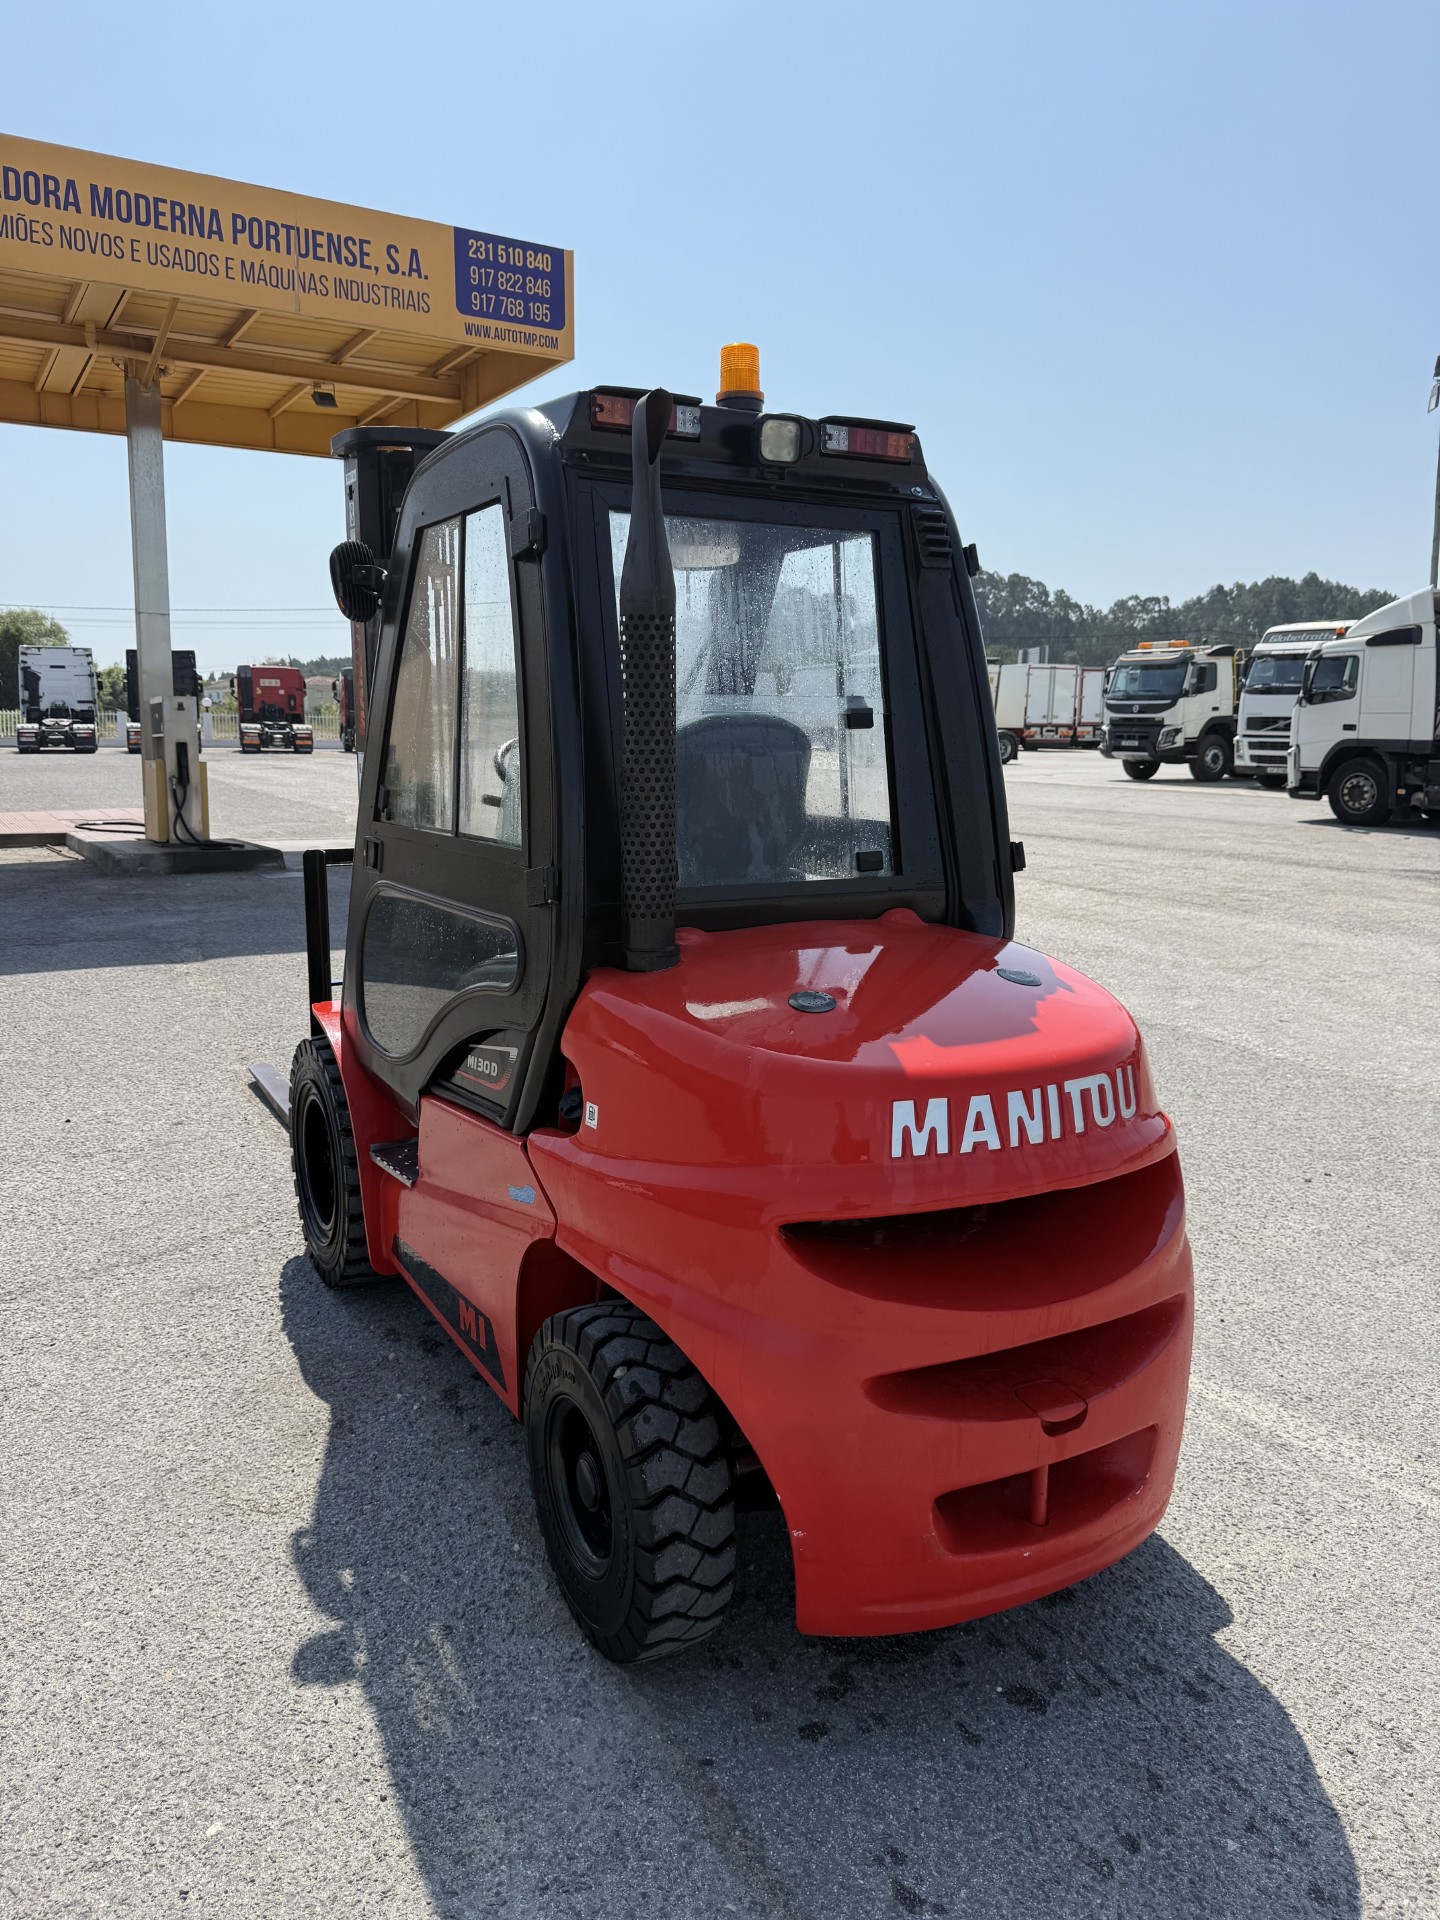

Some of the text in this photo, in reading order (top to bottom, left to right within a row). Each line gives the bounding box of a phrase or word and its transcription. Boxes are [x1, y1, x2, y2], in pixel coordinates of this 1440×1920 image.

[0, 165, 429, 280] DORA MODERNA PORTUENSE, S.A.
[60, 224, 124, 259] NOVOS
[131, 238, 142, 263] E
[146, 241, 220, 277] USADOS
[225, 256, 236, 280] E
[240, 259, 329, 297] MÁQUINAS
[333, 277, 430, 314] INDUSTRIAIS
[468, 239, 552, 272] 231 510 840
[470, 265, 551, 298] 917 822 846
[471, 291, 551, 323] 917 768 195
[464, 321, 559, 350] WWW.AUTOTMP.COM
[891, 1065, 1137, 1158] MANITOU
[458, 1296, 487, 1351] MI
